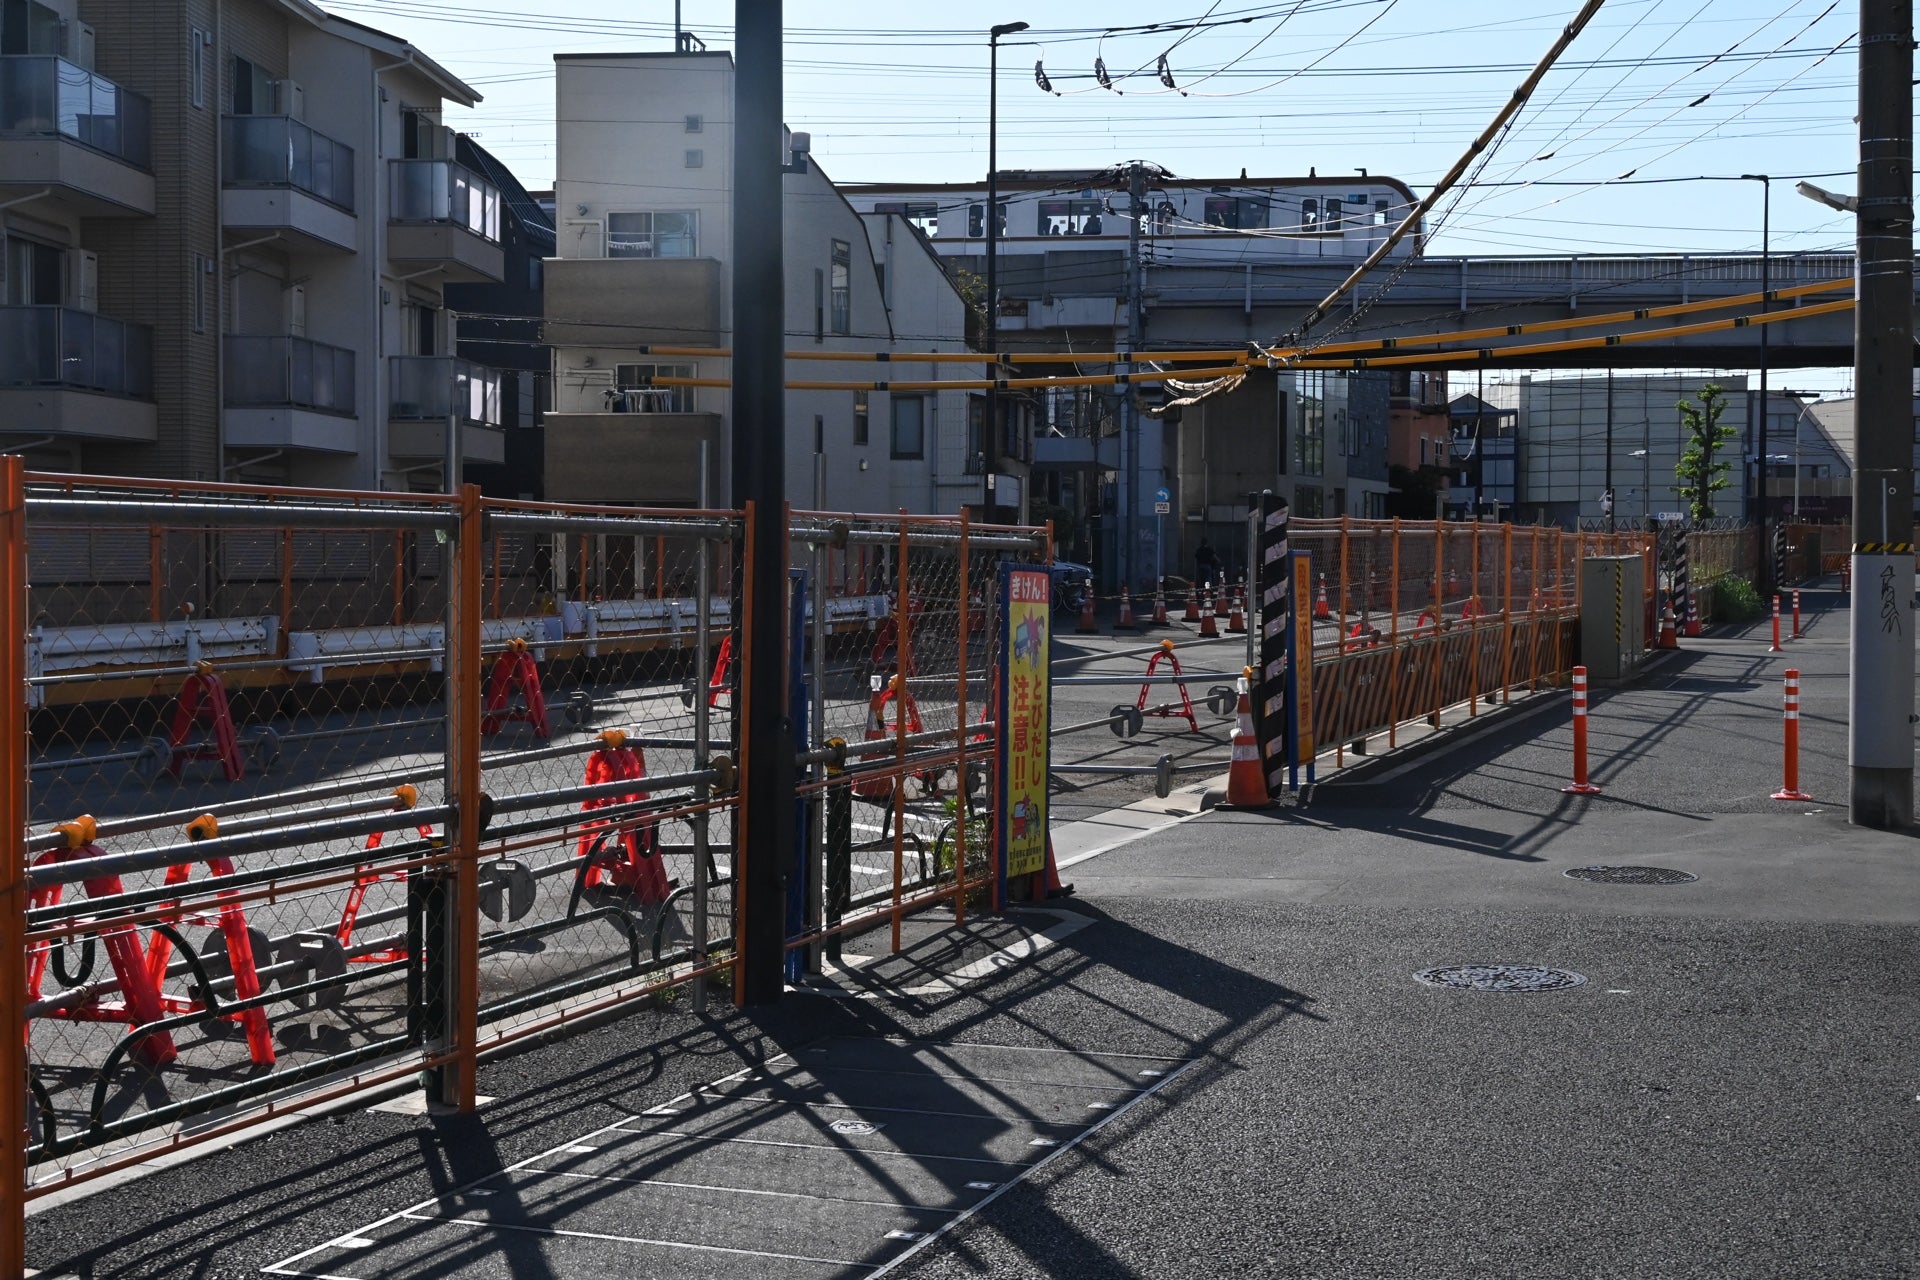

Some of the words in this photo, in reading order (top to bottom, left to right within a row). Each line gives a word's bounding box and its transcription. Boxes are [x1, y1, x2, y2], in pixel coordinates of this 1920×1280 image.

[1012, 575, 1046, 600] きけん!
[1013, 674, 1029, 790] 注意!!
[1031, 674, 1043, 786] とびだし
